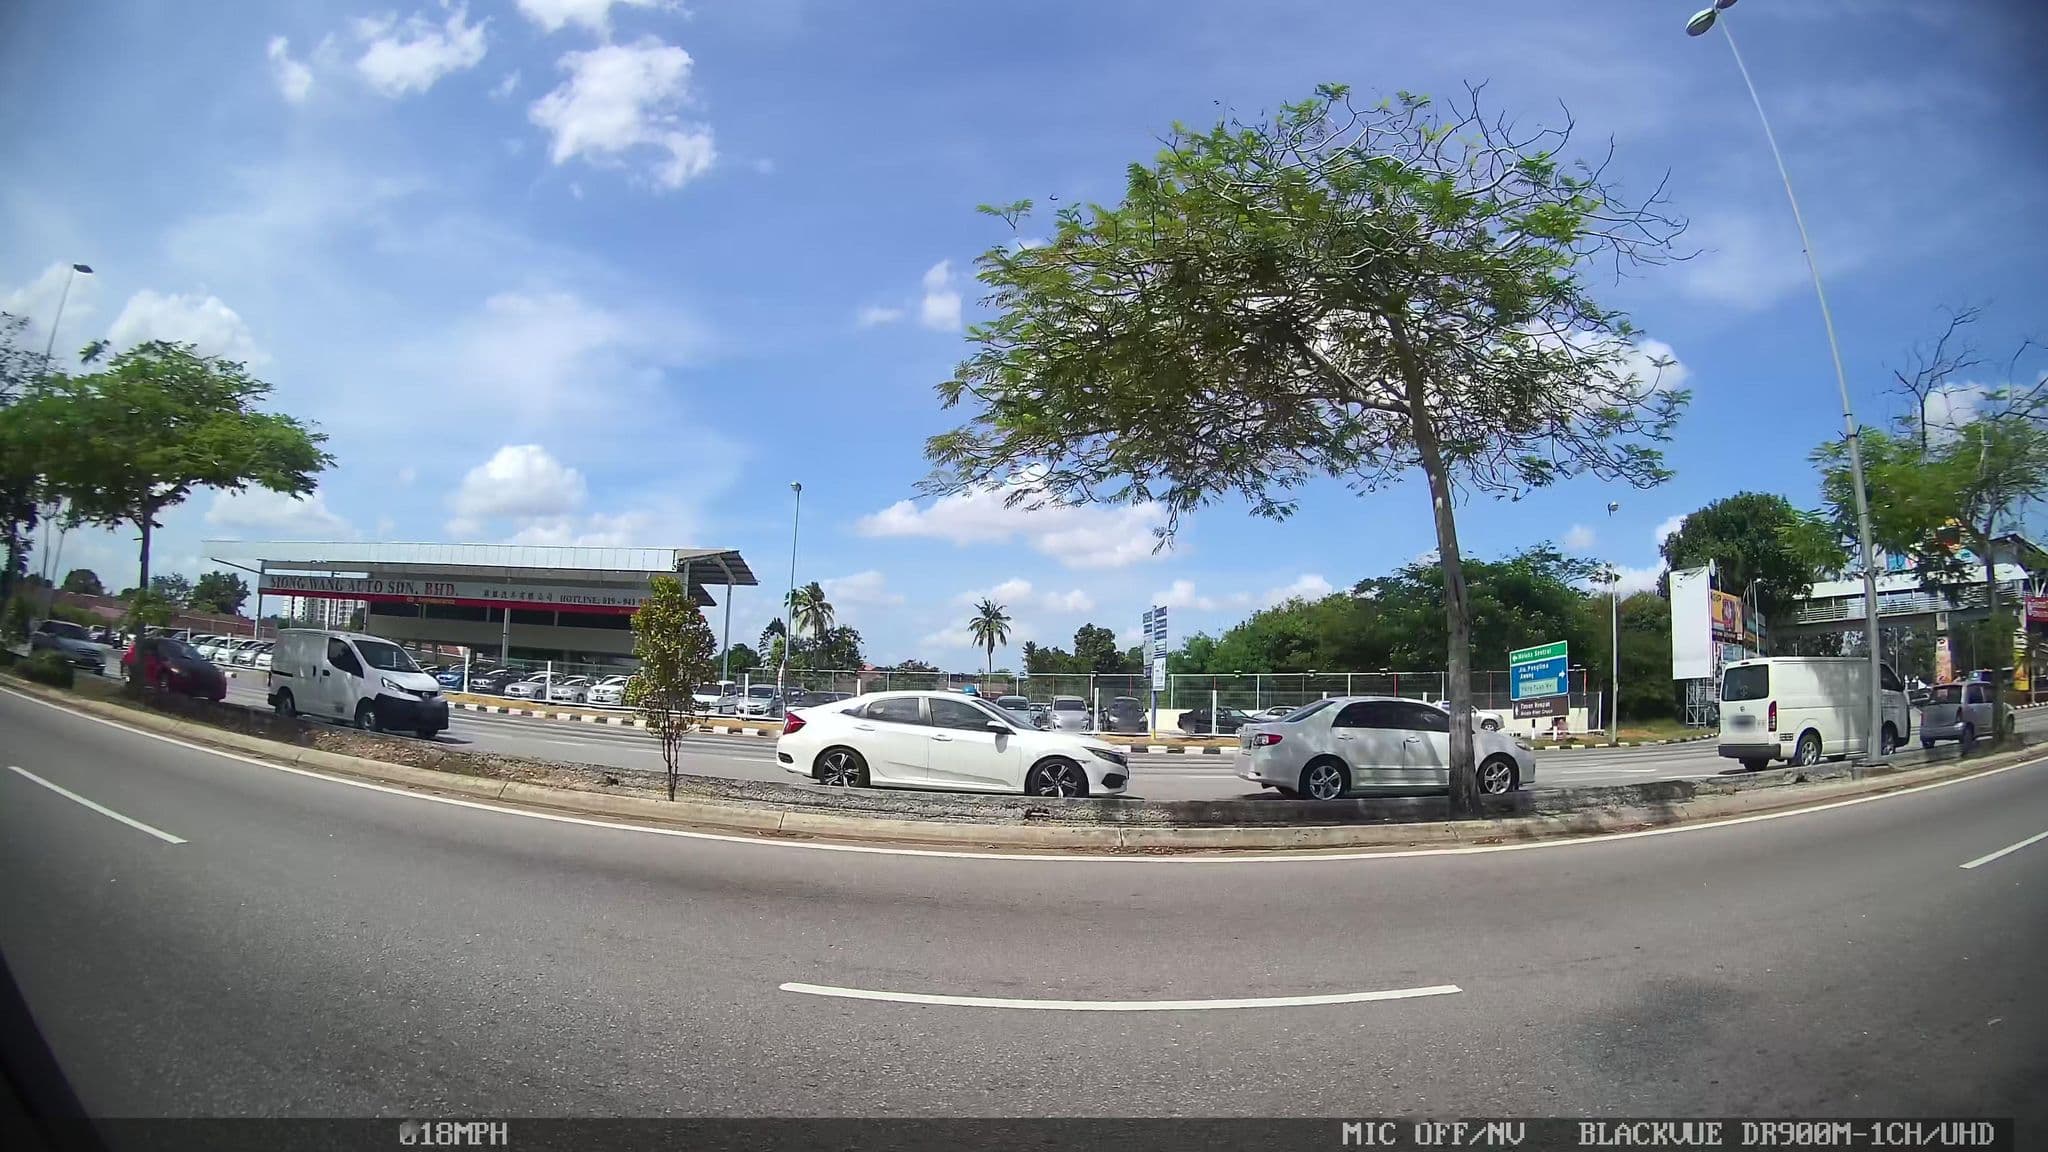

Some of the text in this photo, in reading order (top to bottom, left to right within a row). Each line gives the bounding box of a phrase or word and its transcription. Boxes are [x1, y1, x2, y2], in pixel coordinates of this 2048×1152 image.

[309, 577, 343, 591] WANG
[348, 579, 383, 593] AUTO
[388, 580, 420, 595] SDN.
[425, 582, 459, 596] BHD.
